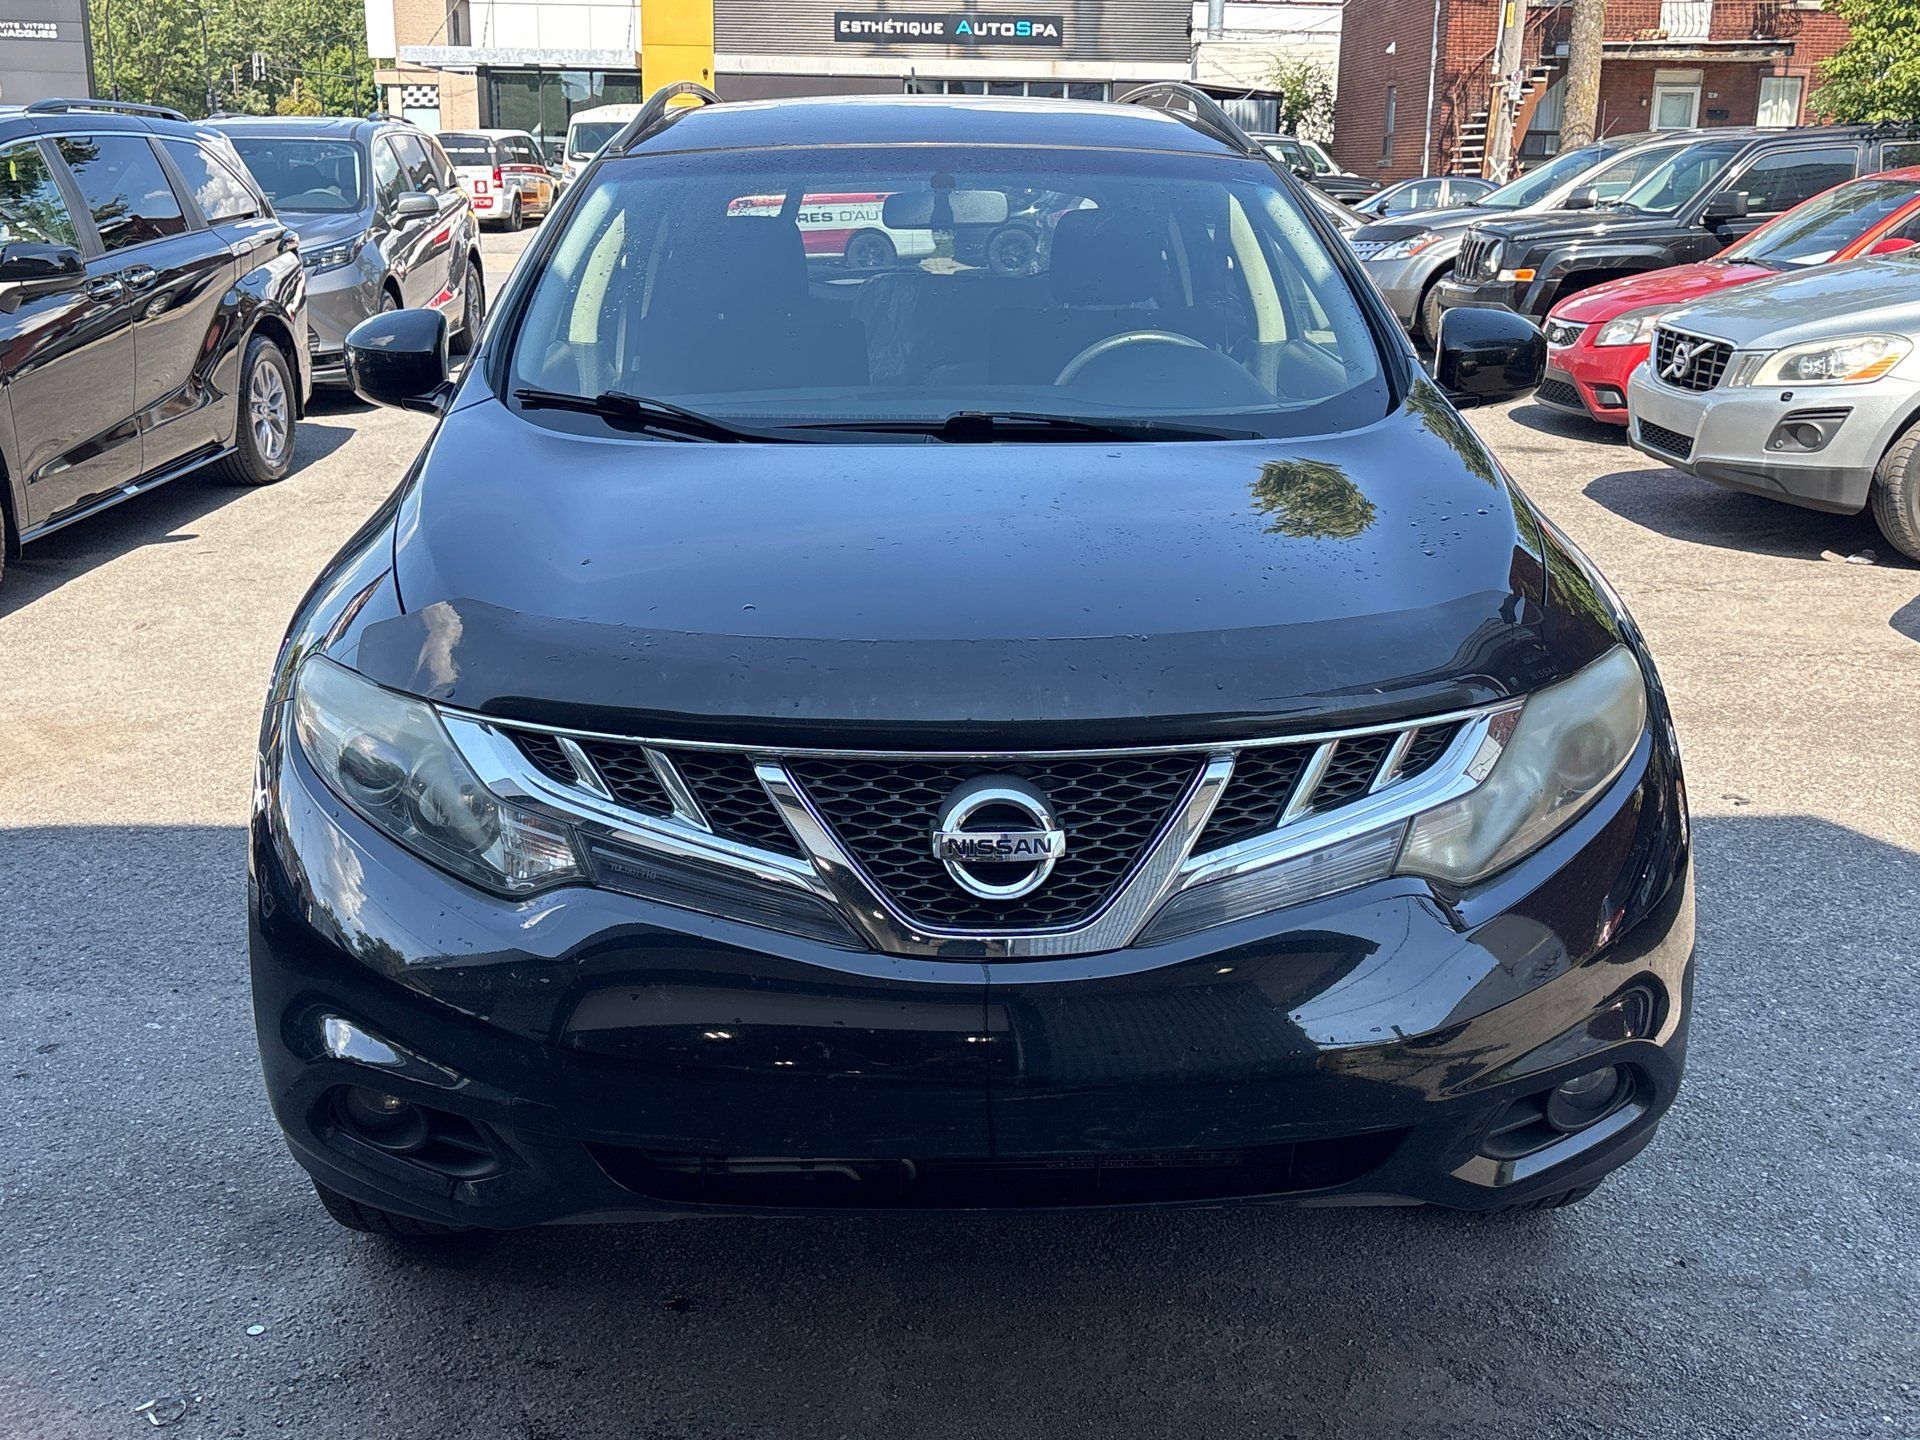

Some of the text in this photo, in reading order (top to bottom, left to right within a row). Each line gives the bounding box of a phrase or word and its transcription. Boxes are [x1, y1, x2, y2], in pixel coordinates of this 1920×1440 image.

[839, 18, 944, 36] ESTHÉTIQUE
[798, 210, 881, 223] RES D'AU
[947, 838, 1052, 854] NISSAN
